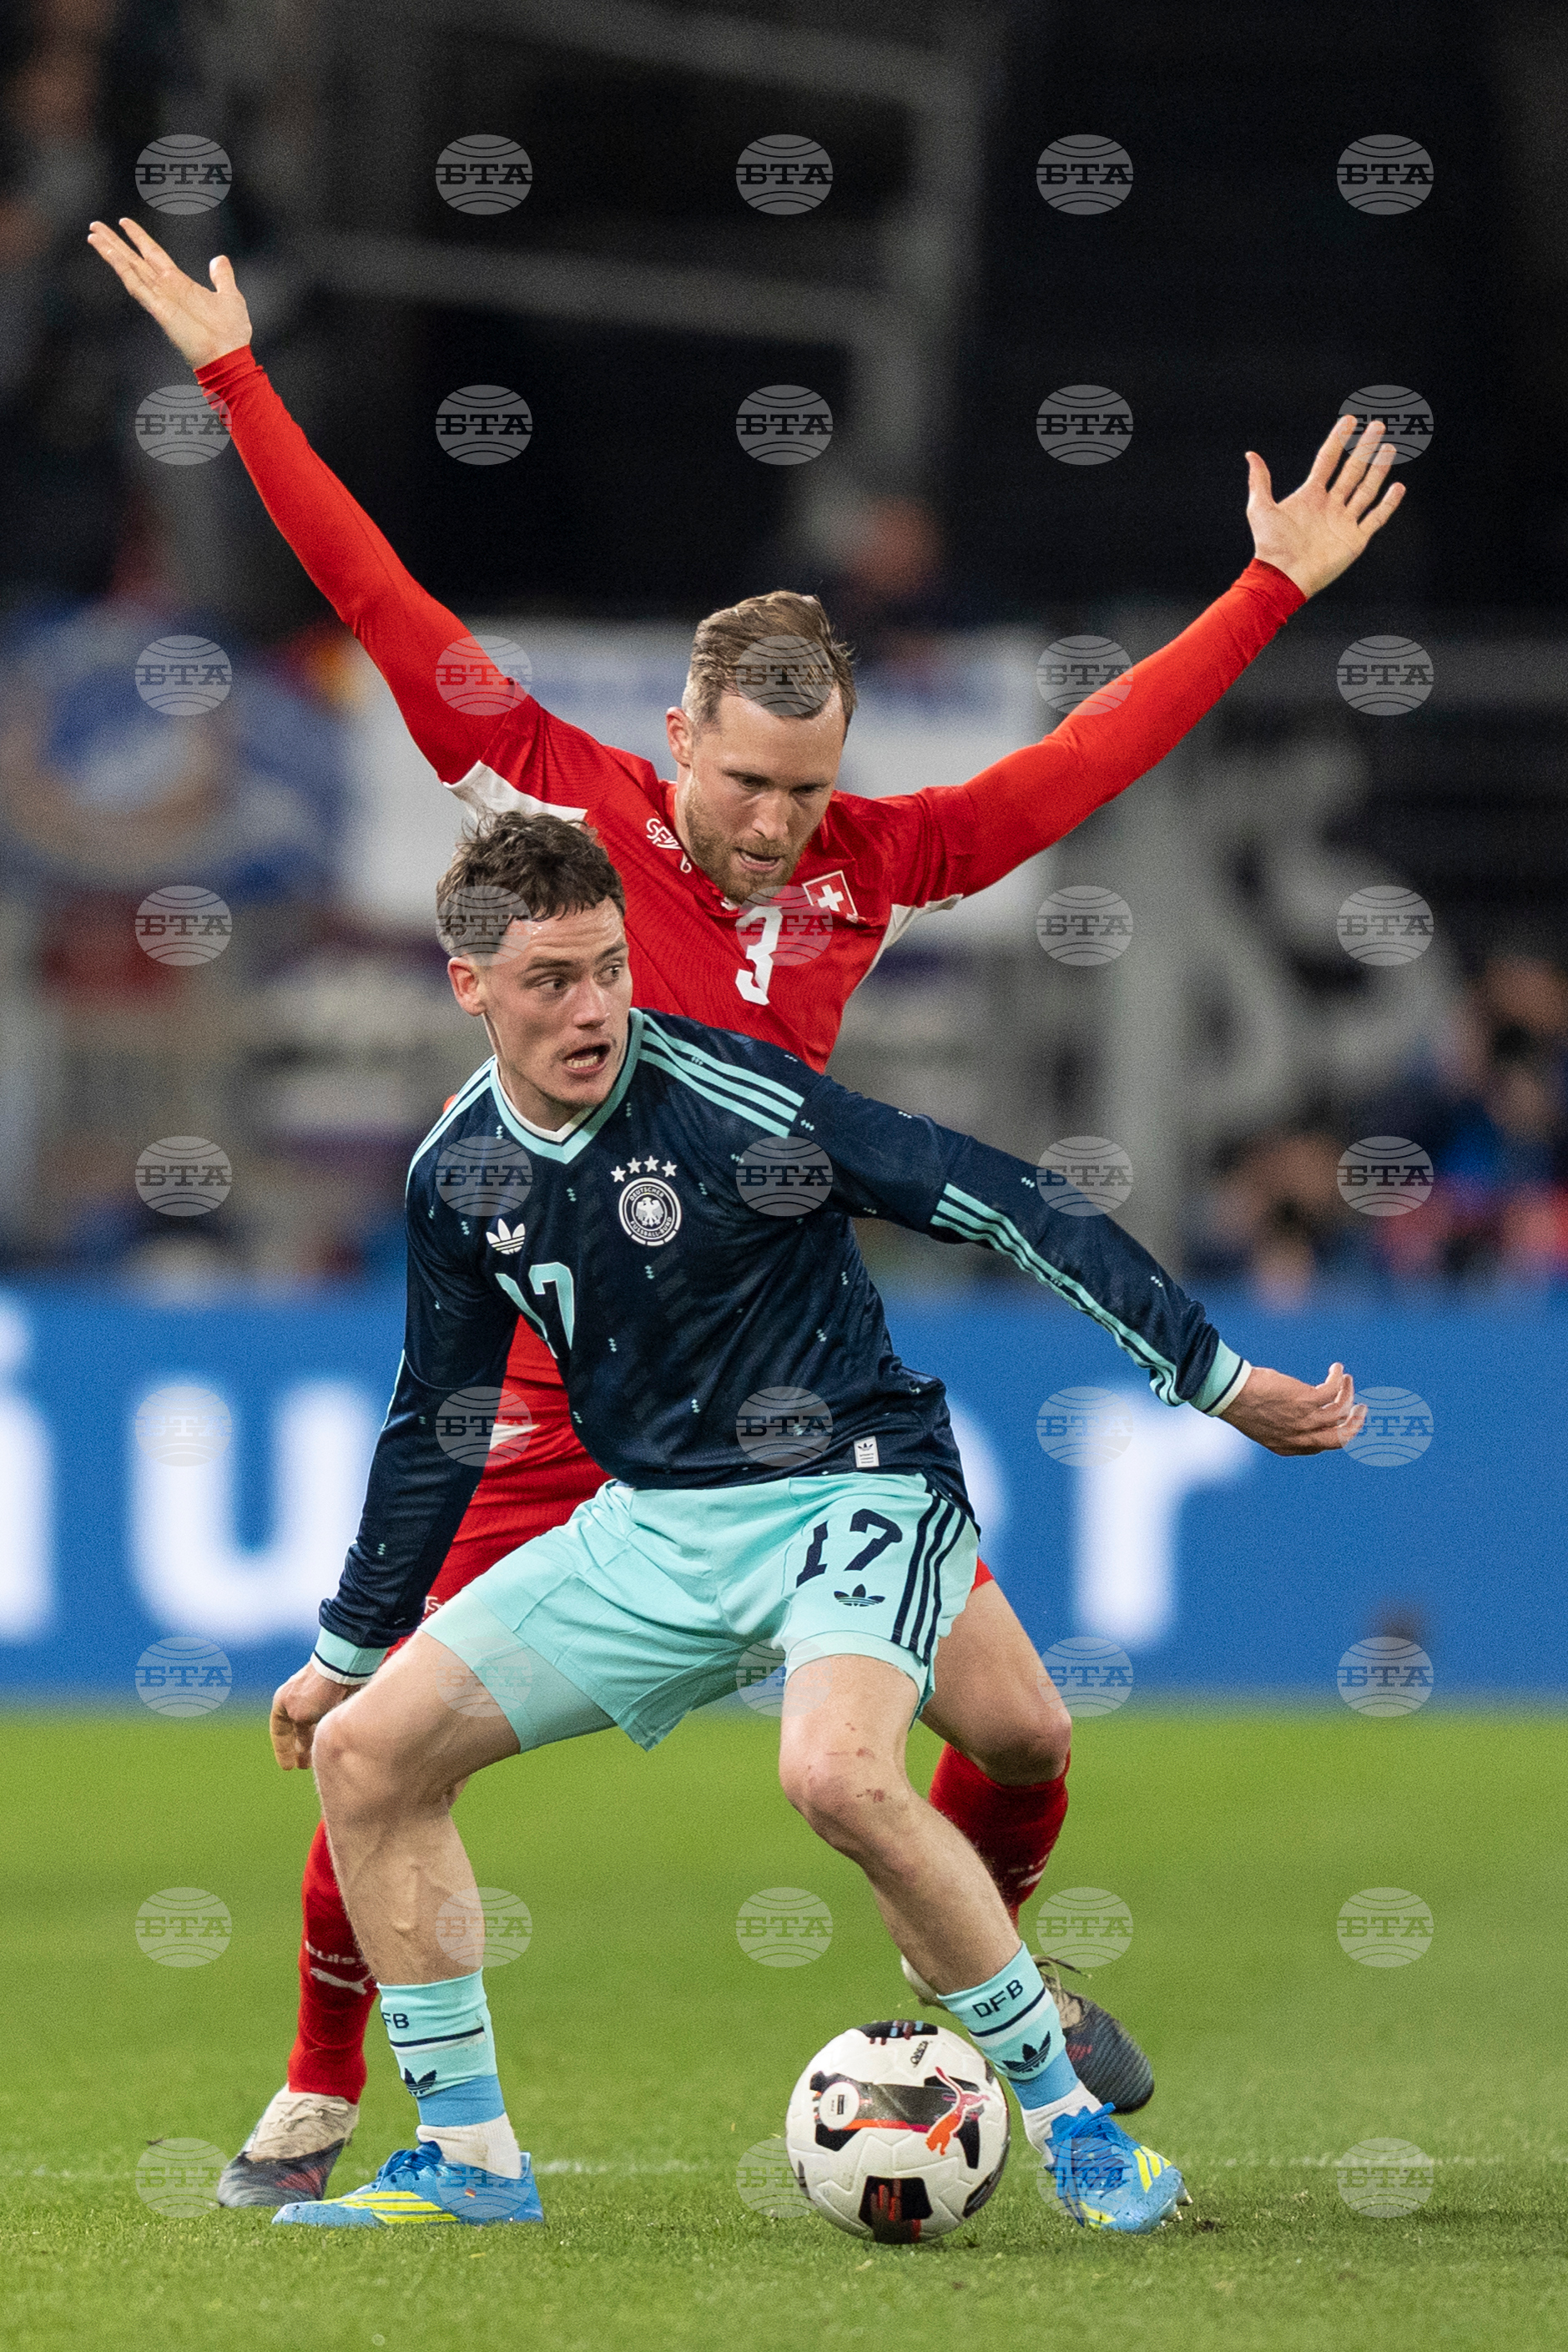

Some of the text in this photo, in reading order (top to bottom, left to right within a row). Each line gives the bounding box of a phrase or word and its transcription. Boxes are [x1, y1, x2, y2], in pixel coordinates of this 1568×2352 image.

[735, 906, 784, 1006] 3
[629, 1187, 665, 1201] DEUTSCHER
[495, 1261, 575, 1360] 17
[795, 1508, 903, 1589] 17
[381, 2011, 410, 2029] FB
[971, 1979, 1024, 2018] DFB
